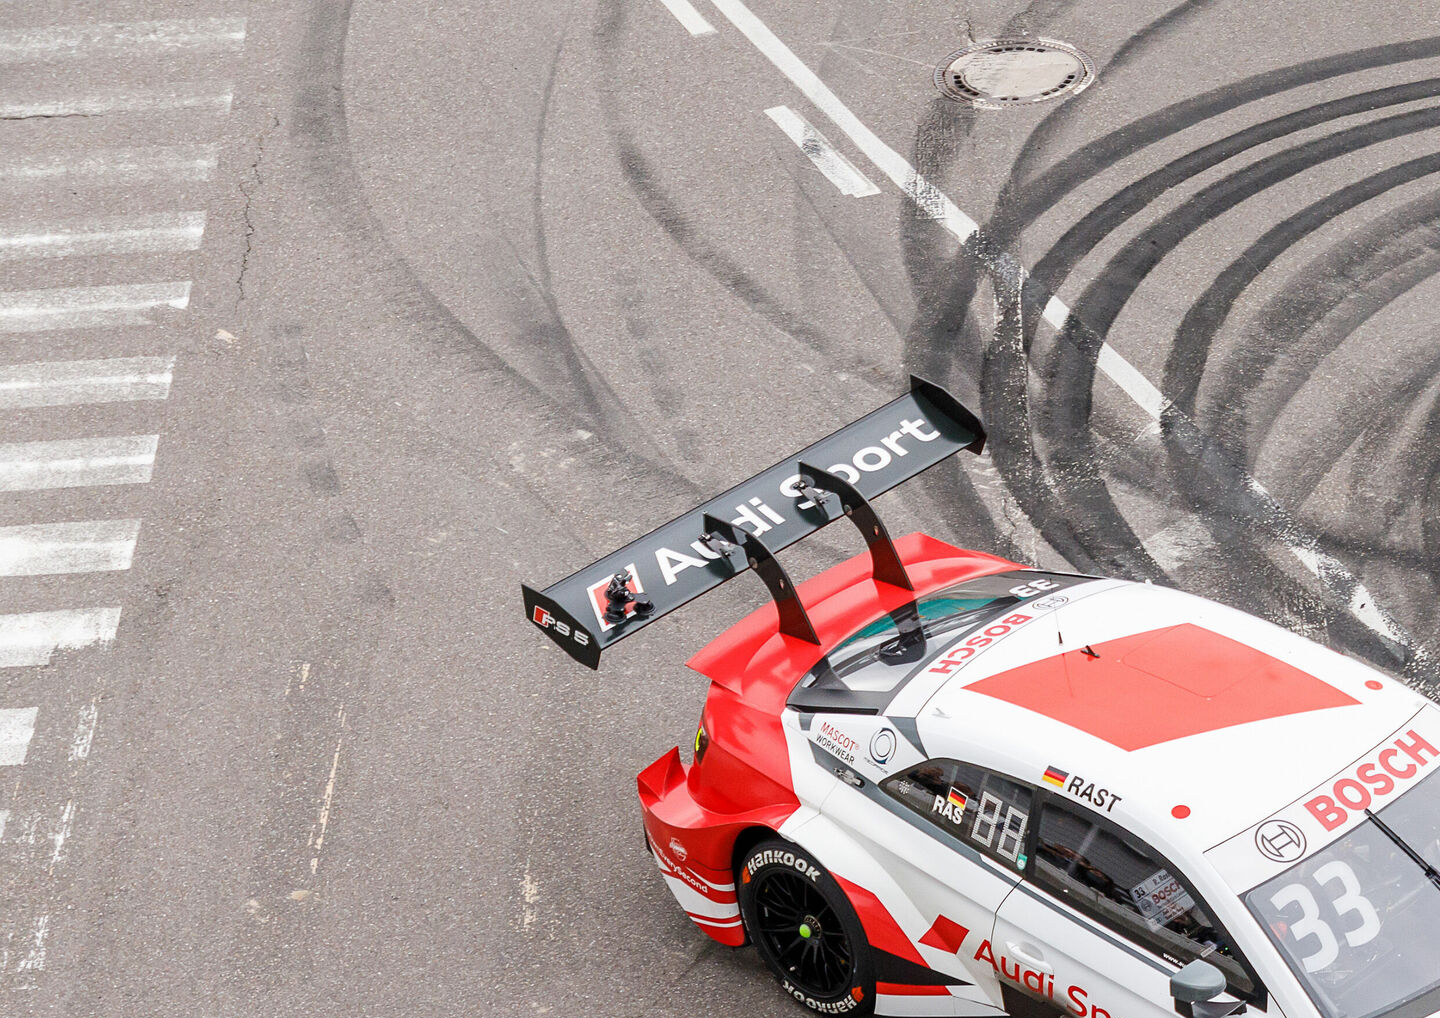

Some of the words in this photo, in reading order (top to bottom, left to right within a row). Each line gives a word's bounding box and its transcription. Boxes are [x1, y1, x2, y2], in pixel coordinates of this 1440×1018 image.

[1009, 579, 1060, 597] 33
[574, 630, 589, 646] 5
[928, 614, 1034, 675] BOSCH
[816, 733, 855, 766] WORKWEAR
[1067, 775, 1123, 813] RAST
[1303, 729, 1440, 833] BOSCH
[1270, 861, 1381, 973] 33
[974, 938, 1055, 1000] Audi
